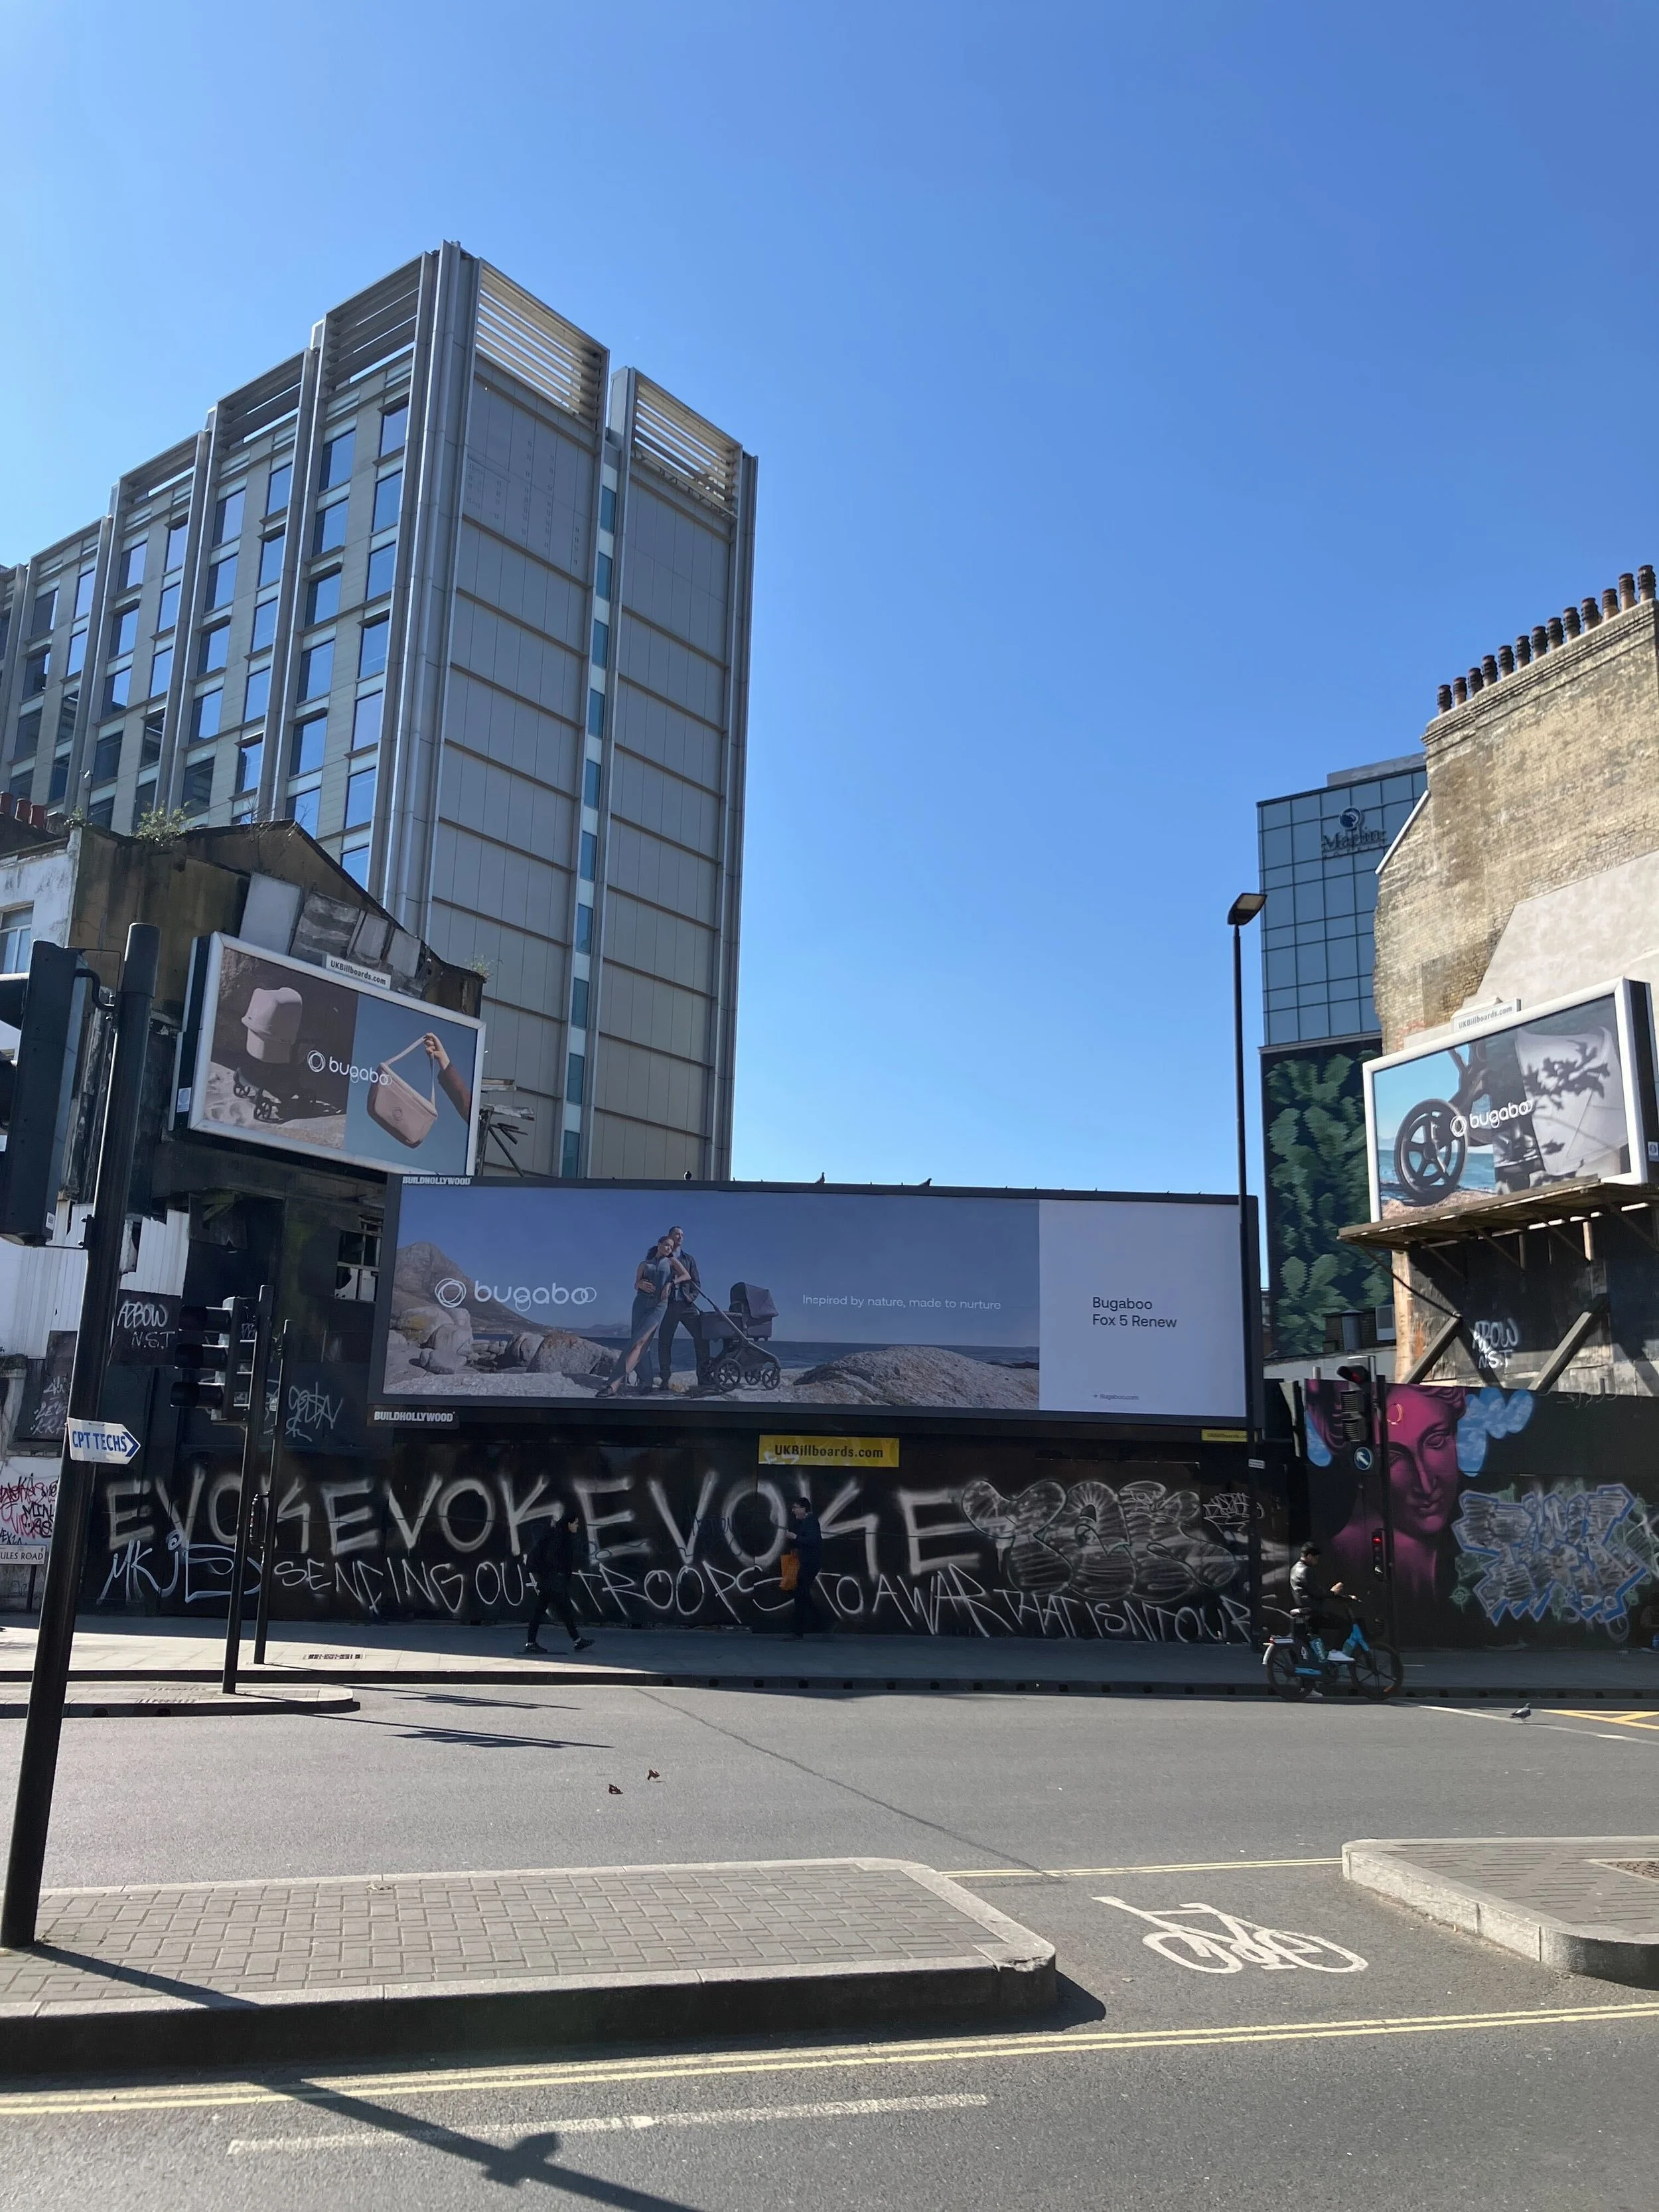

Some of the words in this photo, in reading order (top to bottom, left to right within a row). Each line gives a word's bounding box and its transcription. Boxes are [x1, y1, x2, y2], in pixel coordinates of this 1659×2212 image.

[330, 960, 386, 986] UKBillboards.com
[1459, 1006, 1512, 1029] UKBillboards.com
[329, 1056, 393, 1086] bugaboo
[1469, 1100, 1533, 1129] bugaboo
[402, 1176, 471, 1185] BUILDHOLLYWOOD
[474, 1280, 597, 1311] bugaboo
[803, 1294, 847, 1307] Inspired
[851, 1296, 863, 1308] by
[867, 1297, 906, 1308] nature,
[909, 1298, 942, 1307] made
[945, 1299, 956, 1308] to
[960, 1300, 1001, 1309] nurture
[1092, 1296, 1153, 1311] Bugaboo
[1092, 1314, 1116, 1325] Fox
[1119, 1315, 1127, 1326] 5
[1132, 1315, 1177, 1327] Renew
[374, 1411, 454, 1422] BUILDHOLLYWOOD
[72, 1430, 90, 1449] CPT
[93, 1433, 127, 1452] TECHS
[774, 1444, 883, 1458] UKBillboards.com
[21, 1552, 44, 1560] ROAD
